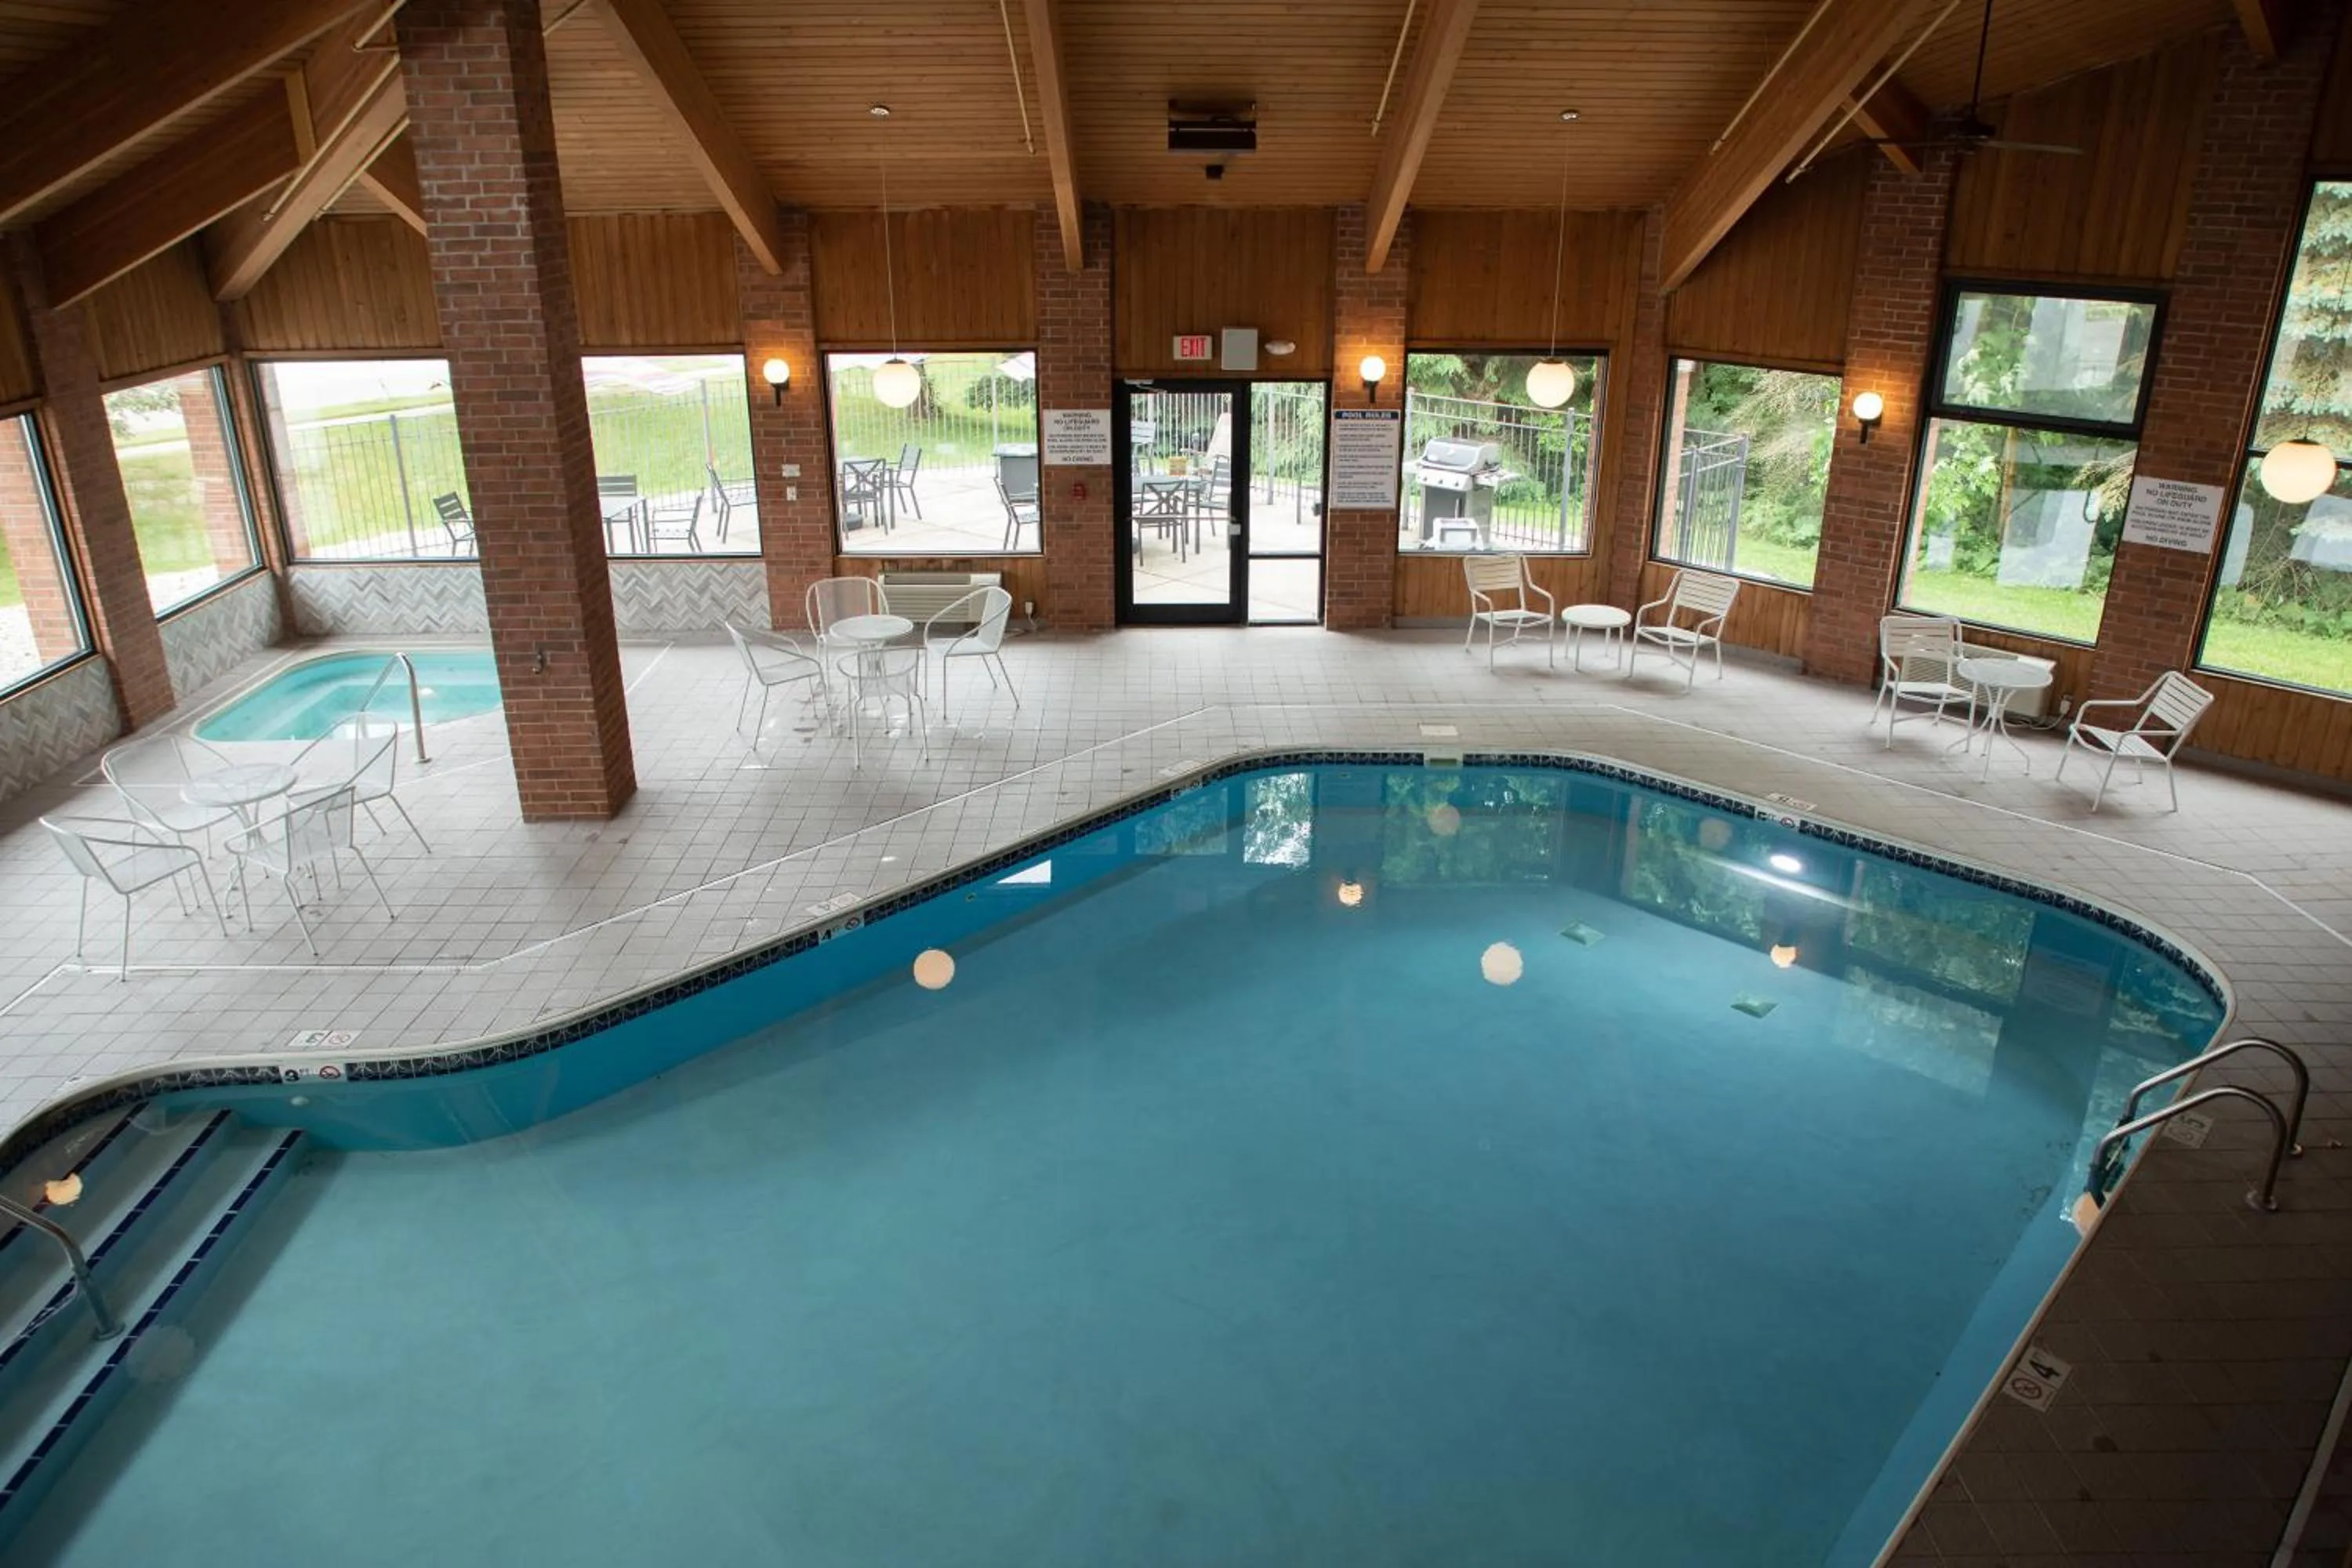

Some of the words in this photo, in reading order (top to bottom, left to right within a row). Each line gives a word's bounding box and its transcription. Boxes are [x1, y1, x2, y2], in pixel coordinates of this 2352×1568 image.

[1180, 337, 1207, 358] EXIT
[285, 1069, 299, 1082] 3
[2029, 1359, 2060, 1379] 4
